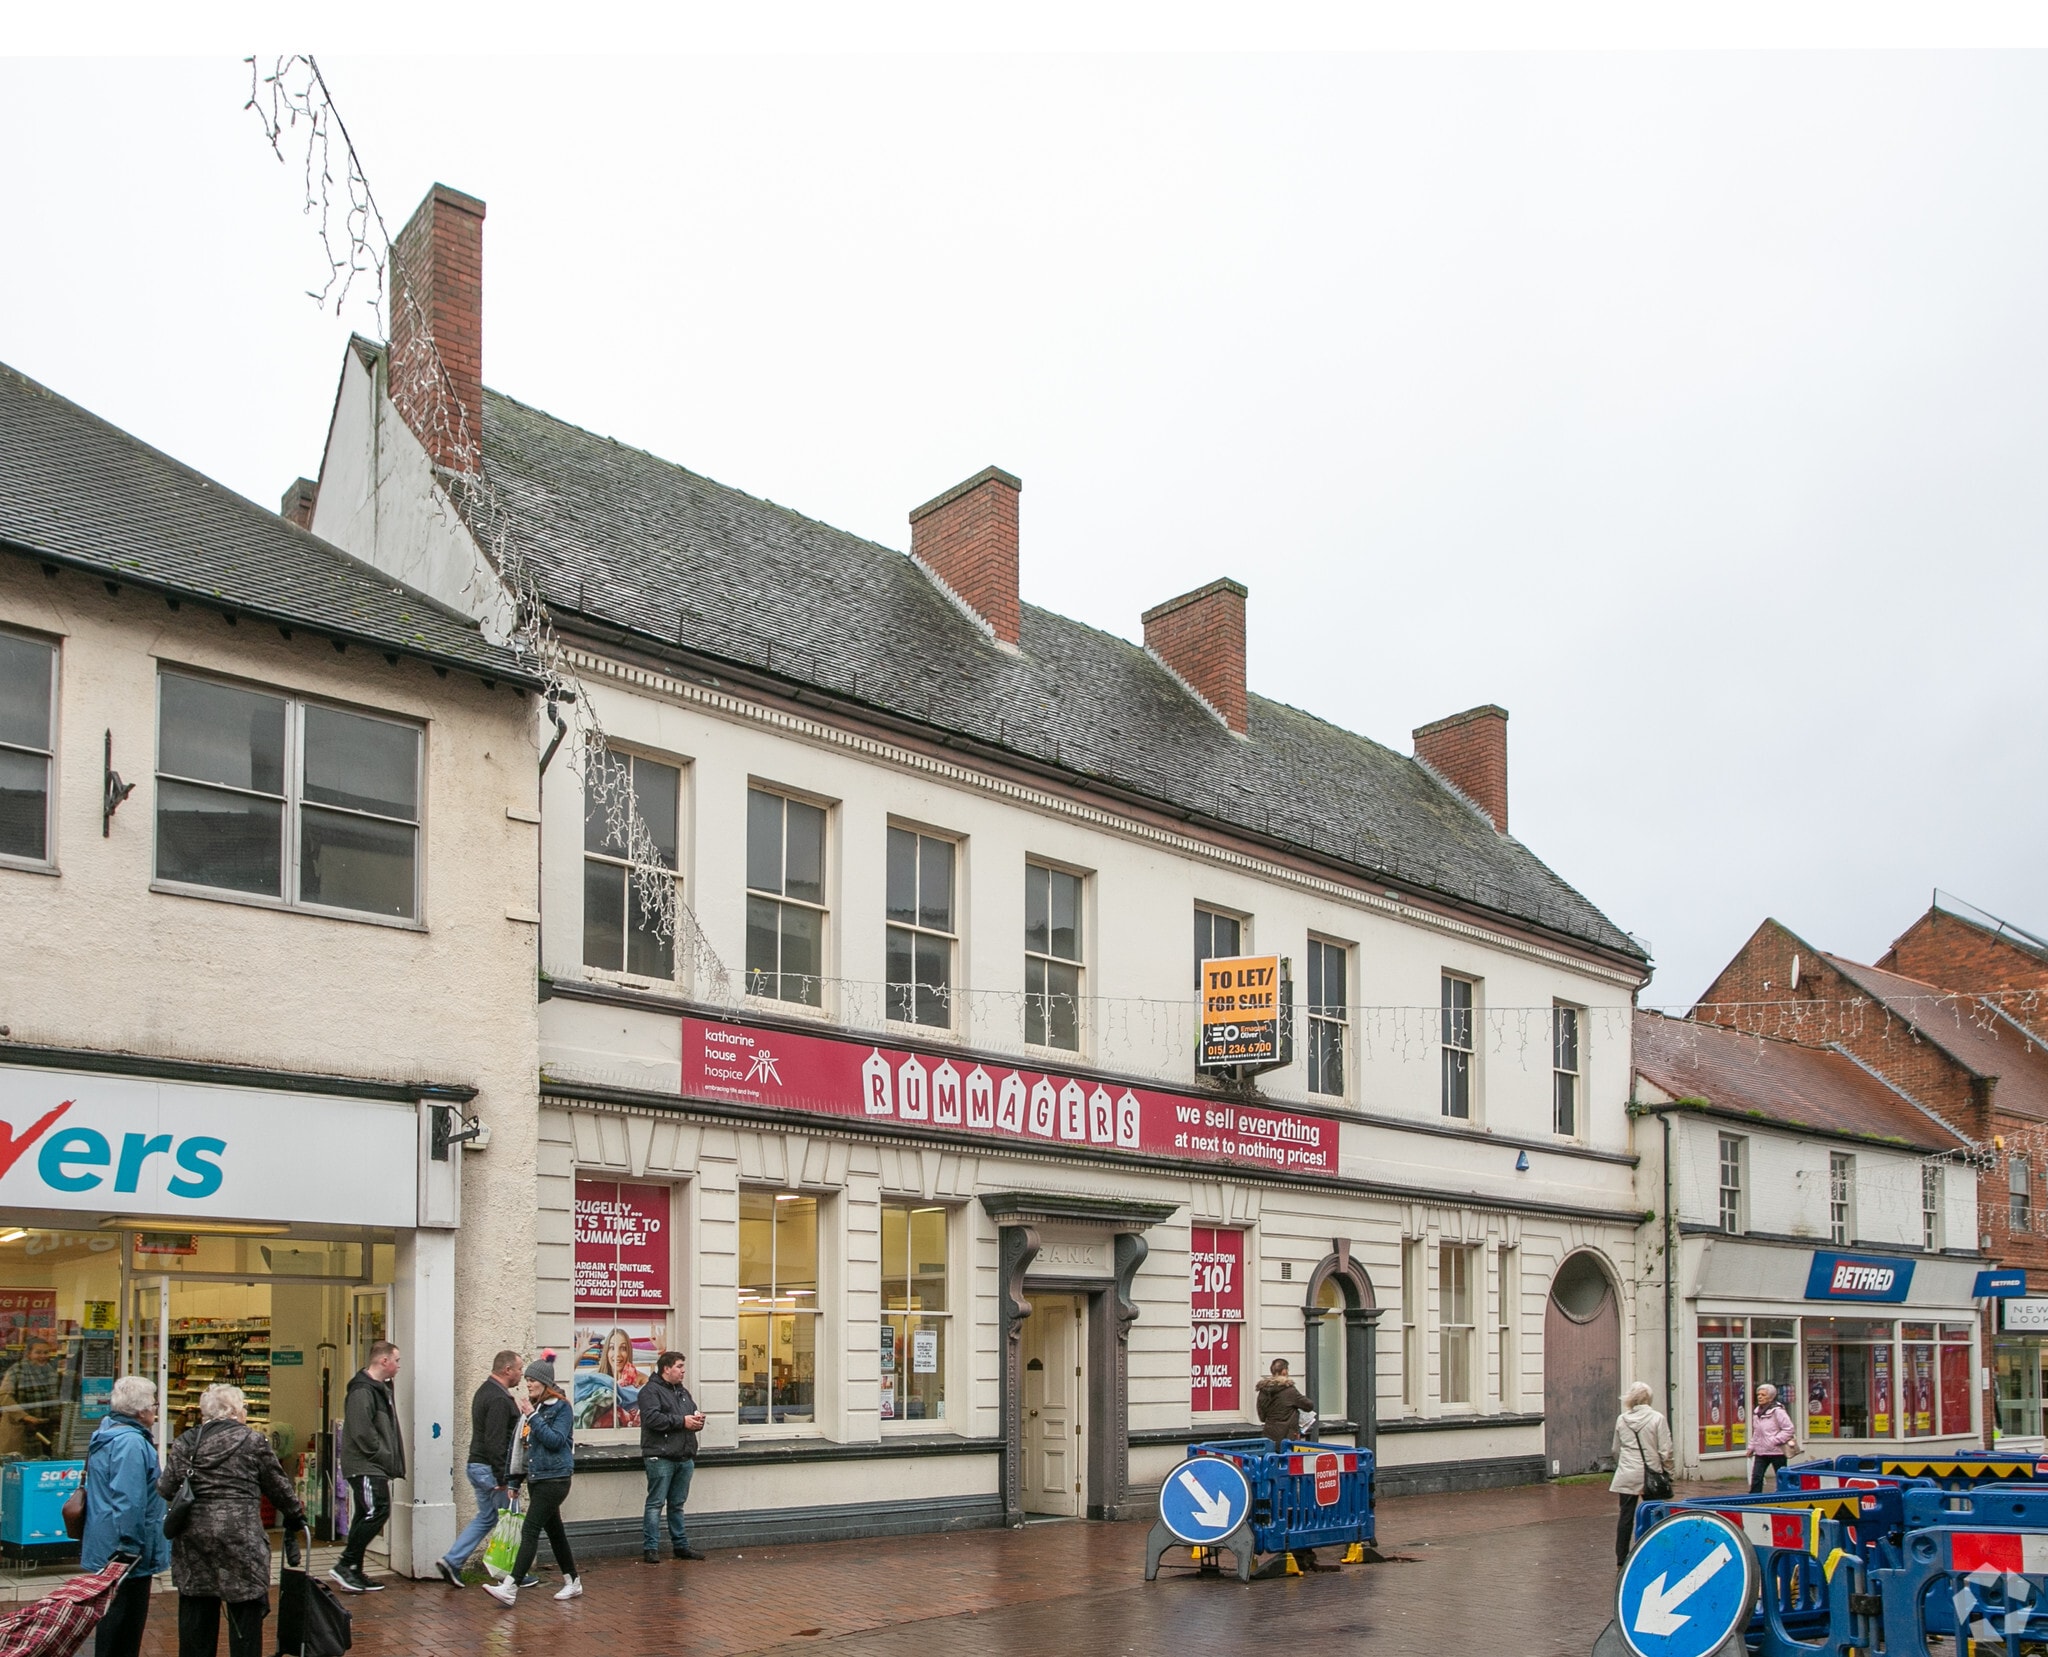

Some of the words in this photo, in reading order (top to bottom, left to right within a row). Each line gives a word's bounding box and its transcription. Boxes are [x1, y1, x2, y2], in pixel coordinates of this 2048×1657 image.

[1209, 971, 1232, 990] TO
[1238, 967, 1274, 988] LET/
[1208, 995, 1235, 1012] FOR
[1239, 992, 1272, 1010] SALE
[705, 1028, 754, 1047] katharine
[705, 1046, 736, 1062] house
[1229, 1044, 1246, 1054] 236
[1248, 1042, 1272, 1052] 6700
[704, 1064, 743, 1081] hospice
[705, 1085, 729, 1094] embracing
[872, 1074, 1134, 1139] RUMMAGERS
[1176, 1106, 1200, 1124] we
[1205, 1108, 1234, 1130] sell
[1238, 1116, 1320, 1147] everything
[1175, 1132, 1188, 1148] at
[1192, 1136, 1220, 1153] next
[1222, 1139, 1235, 1154] to
[1238, 1142, 1284, 1165] nothing
[1288, 1148, 1326, 1166] prices!
[575, 1215, 598, 1229] T'S
[642, 1219, 660, 1232] TO
[575, 1230, 646, 1246] RUMMAGE!
[1036, 1246, 1094, 1264] BANK
[1216, 1253, 1236, 1264] FROM
[575, 1262, 606, 1270] ARGAIN
[575, 1270, 609, 1279] LOTHING
[1192, 1263, 1232, 1293] £10!
[1832, 1266, 1895, 1291] BETFRED
[575, 1279, 616, 1288] OUSEHOLD
[575, 1288, 587, 1296] ND
[590, 1288, 613, 1296] MUCH
[641, 1290, 662, 1298] MORE
[1222, 1309, 1242, 1318] FROM
[2013, 1306, 2048, 1314] NEW
[1192, 1324, 1229, 1350] 20P!
[1191, 1365, 1201, 1376] ND
[1204, 1365, 1228, 1376] MUCH
[1192, 1376, 1208, 1388] UCH
[1211, 1376, 1232, 1388] MORE
[1316, 1470, 1337, 1479] FOOTWAY
[1319, 1480, 1336, 1489] CLOSED
